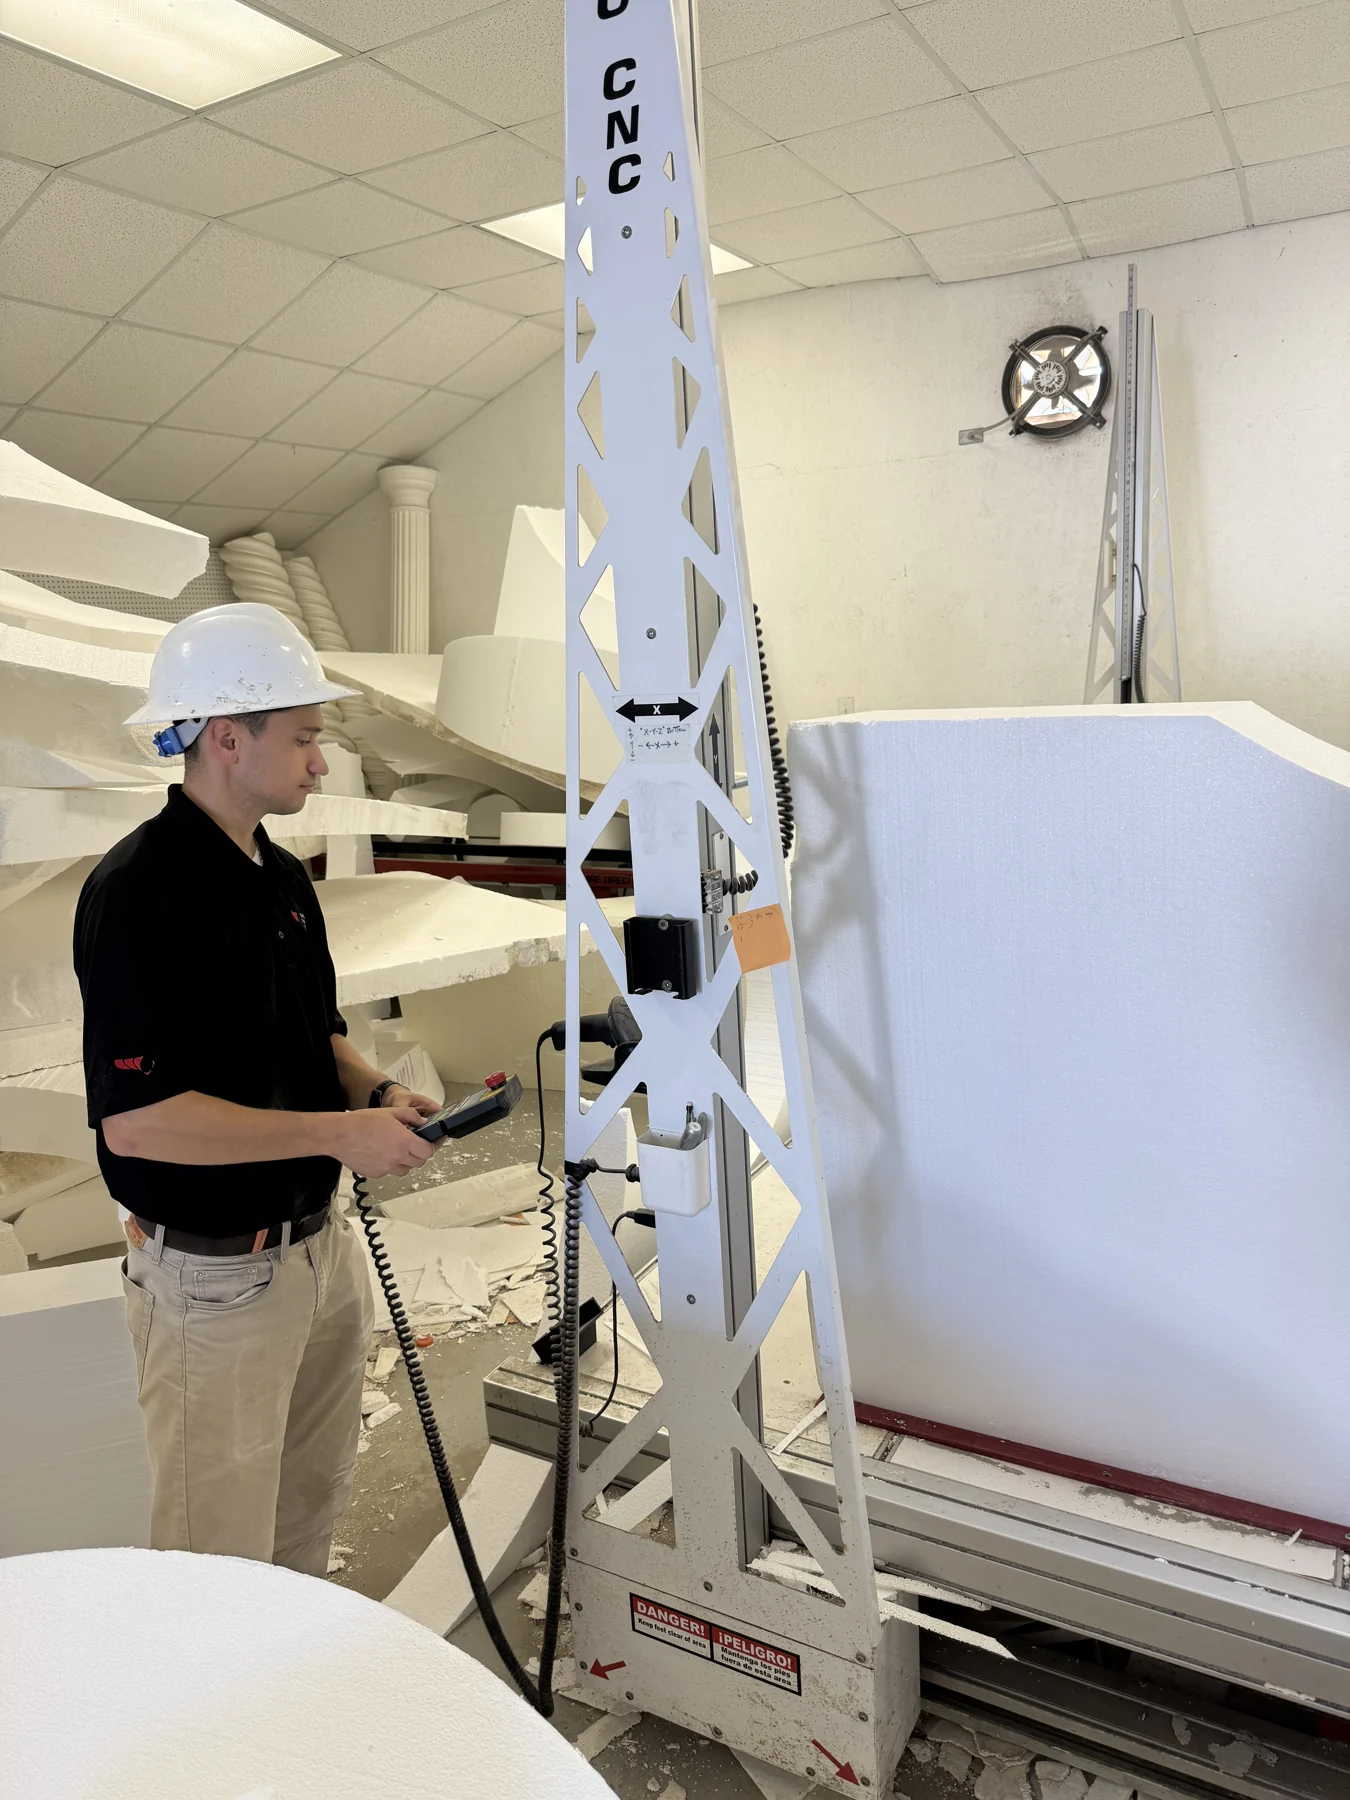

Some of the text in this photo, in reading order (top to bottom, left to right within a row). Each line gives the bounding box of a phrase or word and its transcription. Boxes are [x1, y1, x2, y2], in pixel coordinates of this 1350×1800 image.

[603, 58, 641, 194] CNC
[653, 705, 661, 714] X
[637, 1601, 705, 1636] DANGER!
[638, 1618, 653, 1629] Keep
[655, 1624, 667, 1633] feet
[668, 1630, 683, 1640] clear
[692, 1640, 706, 1649] area
[719, 1632, 791, 1669] ¡PELIGRO!
[721, 1647, 790, 1678] Mantenga los pies
[721, 1655, 791, 1686] fuera de esta area
